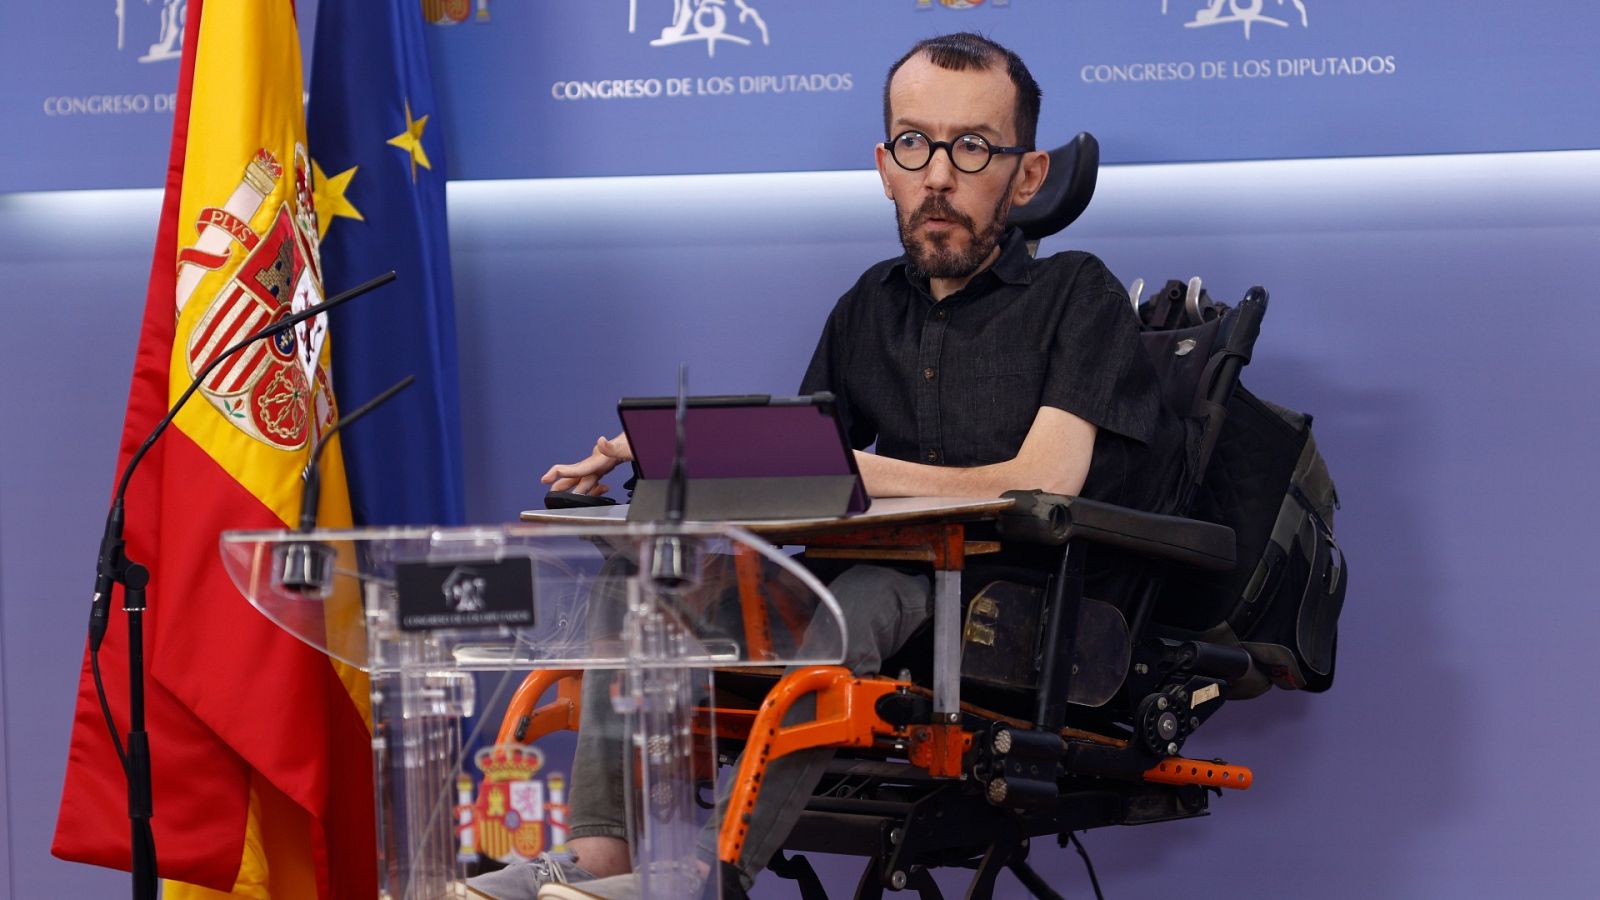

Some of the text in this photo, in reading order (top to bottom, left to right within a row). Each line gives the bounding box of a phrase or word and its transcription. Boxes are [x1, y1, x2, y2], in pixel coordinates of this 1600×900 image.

[1081, 56, 1396, 83] CONGRESO DE LOS DIPUTADOS
[551, 73, 853, 100] CONGRESO DE LOS DIPUTADOS
[43, 94, 149, 116] CONGRESO
